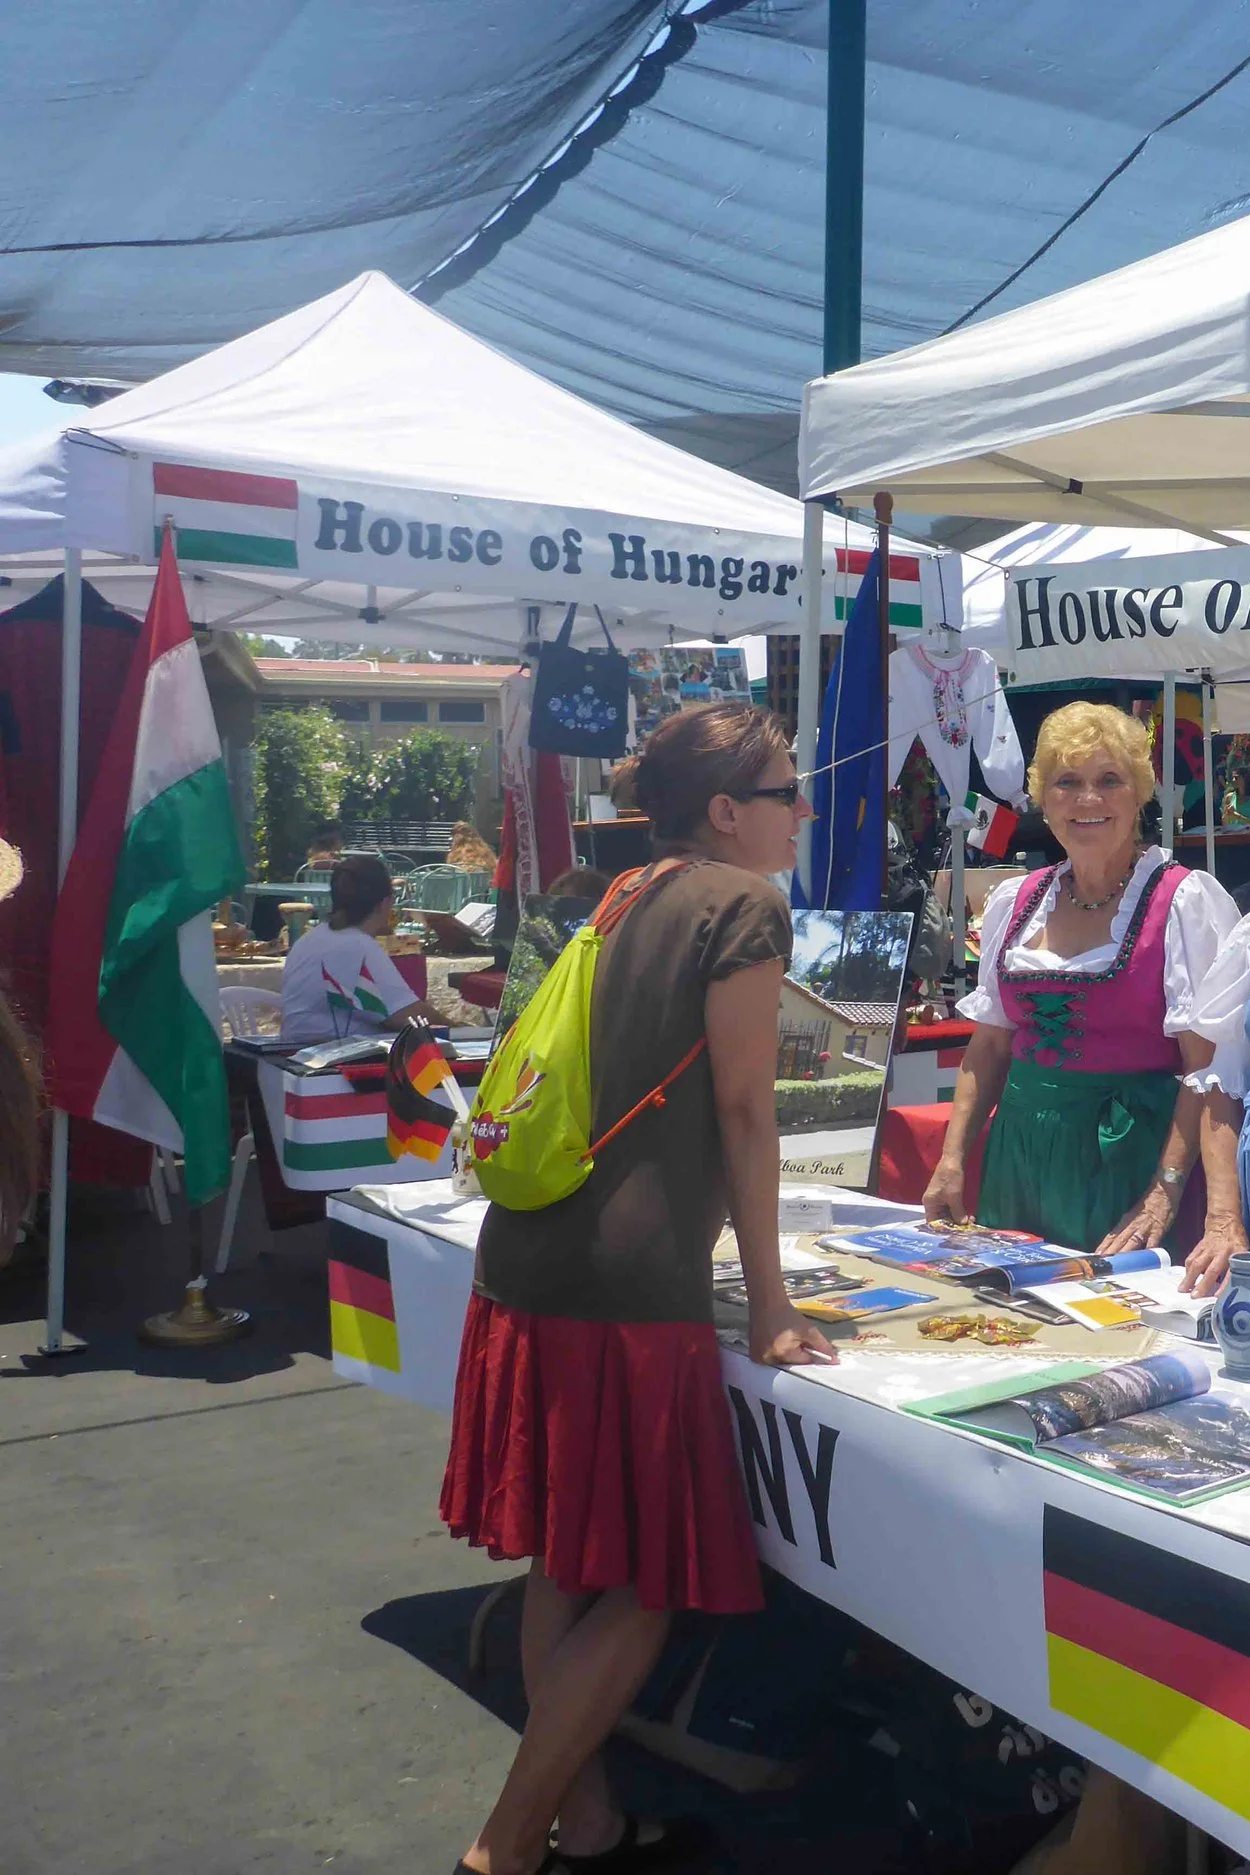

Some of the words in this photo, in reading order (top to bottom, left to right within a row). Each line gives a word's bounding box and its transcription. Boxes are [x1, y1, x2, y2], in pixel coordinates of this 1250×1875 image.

[314, 497, 504, 566] House
[530, 528, 582, 576] of
[609, 532, 825, 607] Hungar
[1015, 574, 1184, 652] House
[810, 1160, 844, 1176] Park
